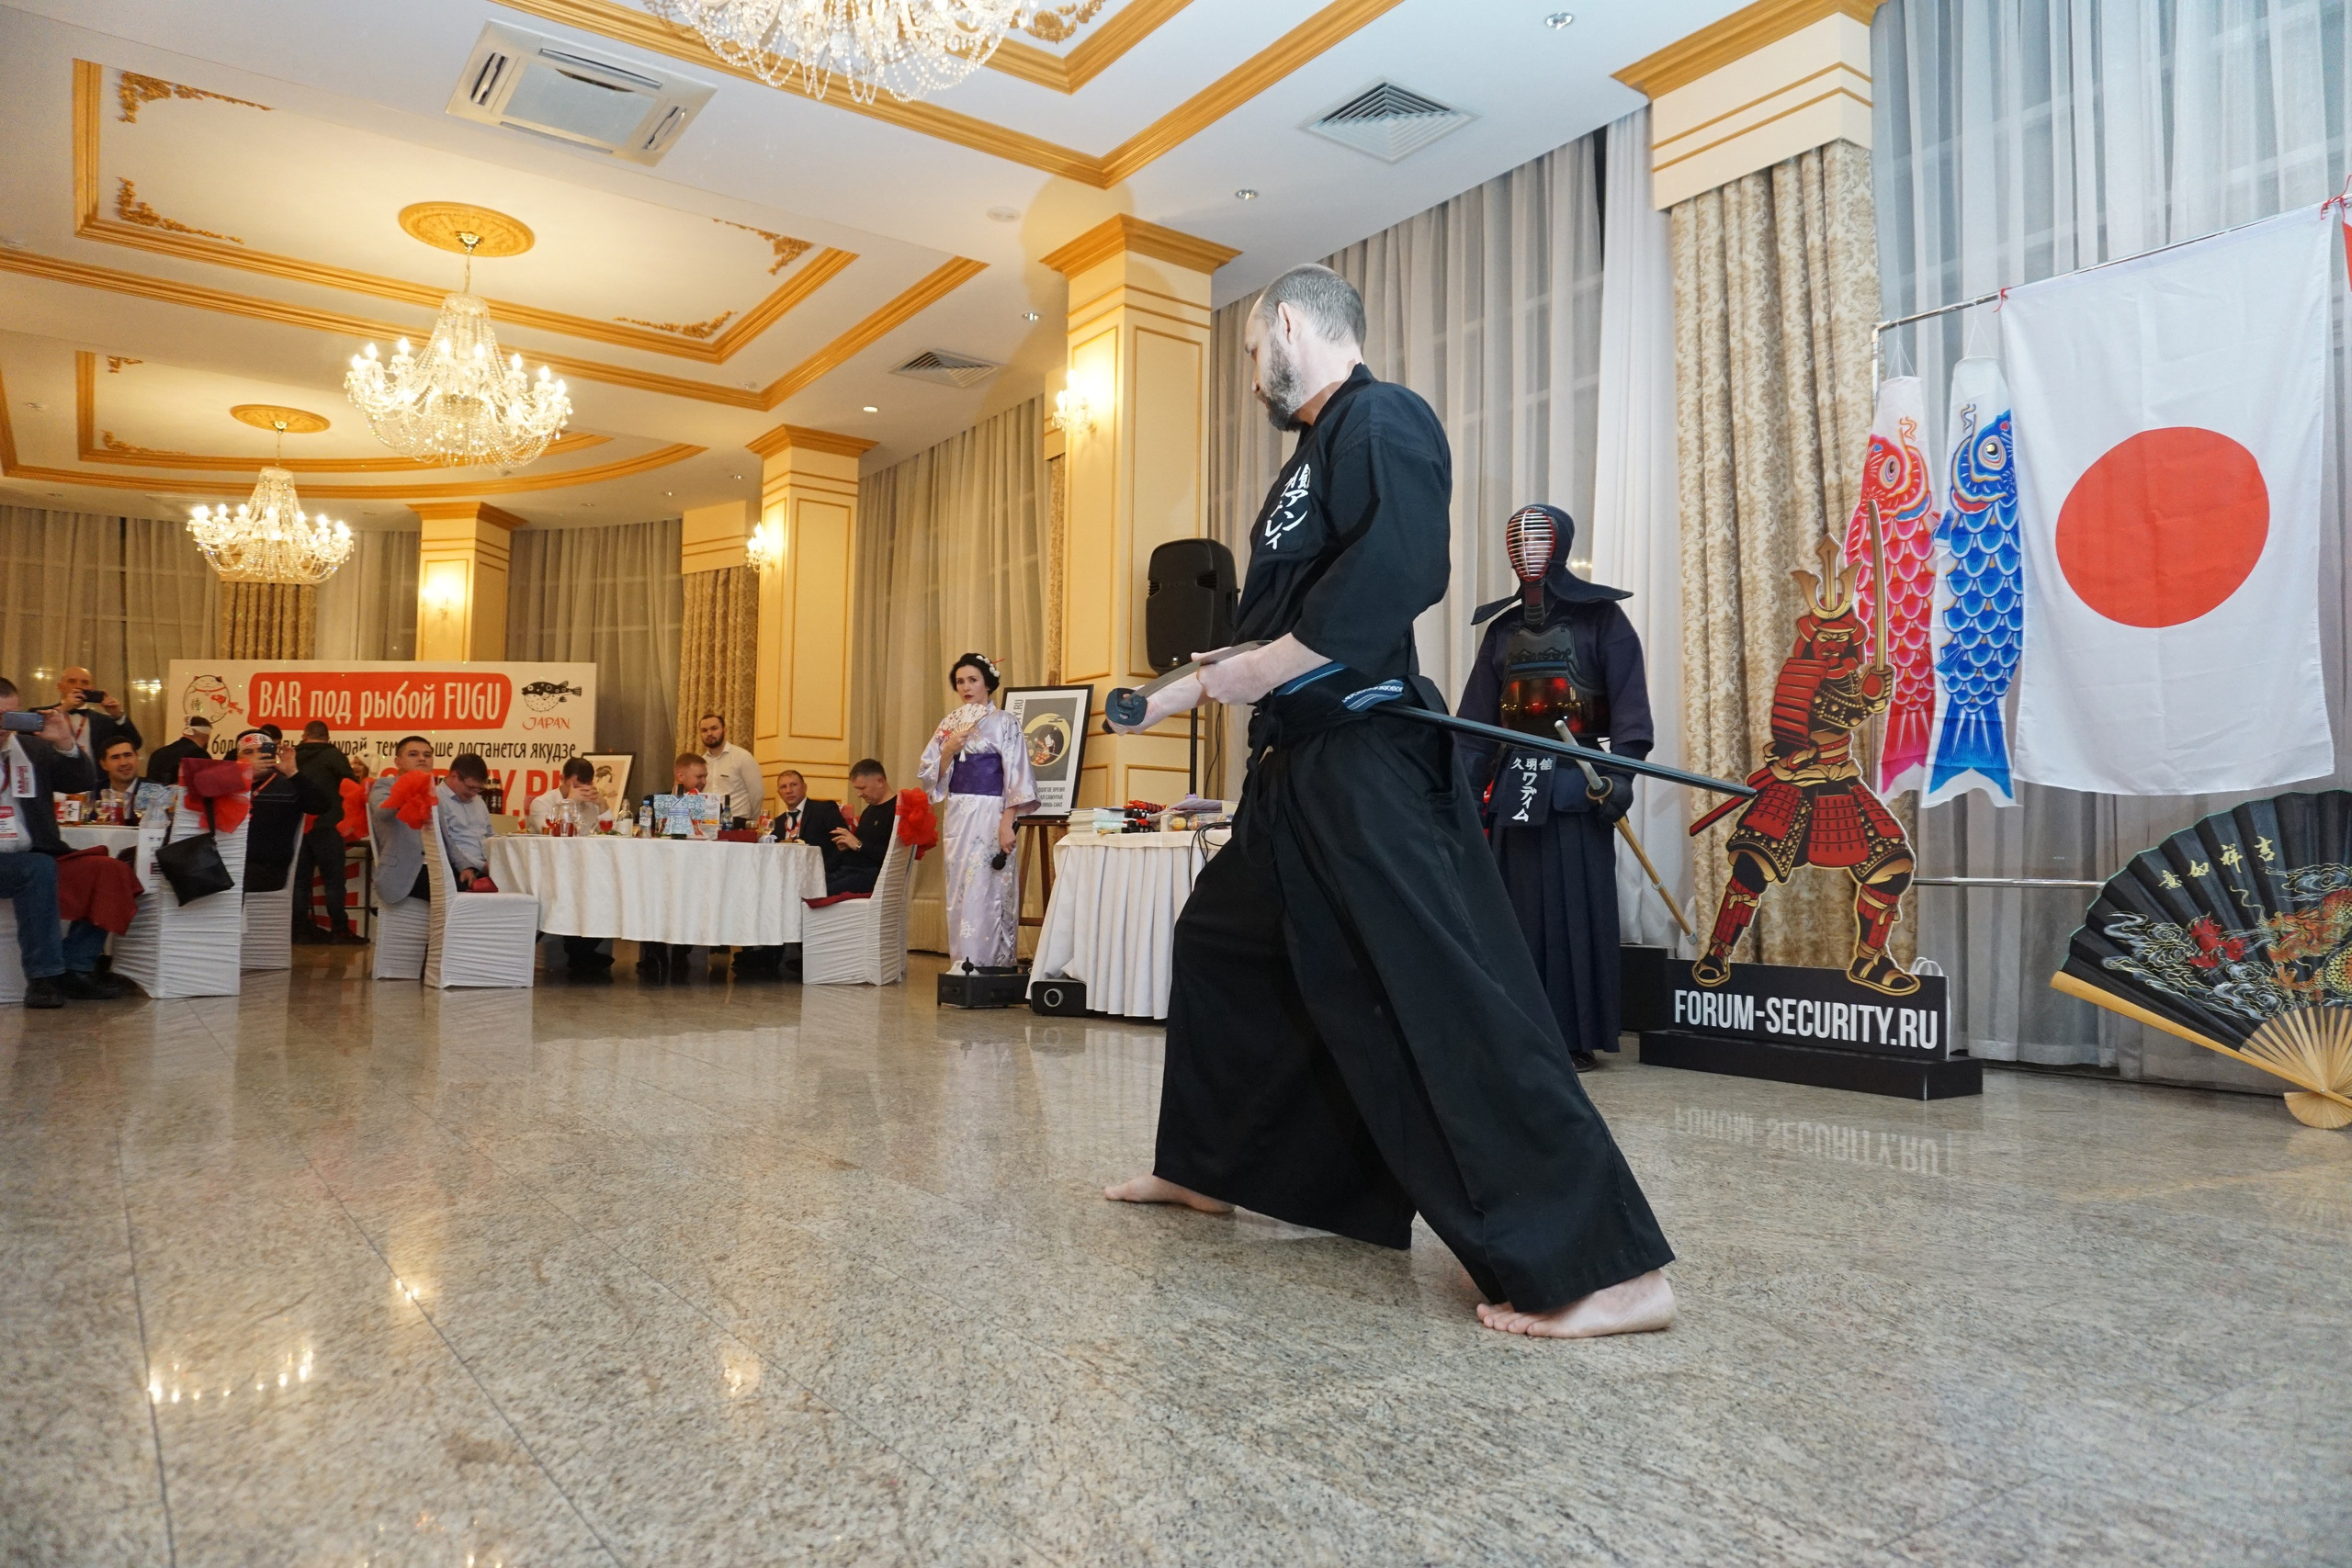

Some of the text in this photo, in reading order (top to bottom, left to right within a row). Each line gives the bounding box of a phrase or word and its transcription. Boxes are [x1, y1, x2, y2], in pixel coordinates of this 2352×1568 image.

[258, 681, 501, 727] BAR под рыбой FUGU
[522, 716, 571, 730] JAPAN
[529, 742, 576, 763] якудзе
[1674, 989, 1939, 1050] FORUM-SECURITY.RU
